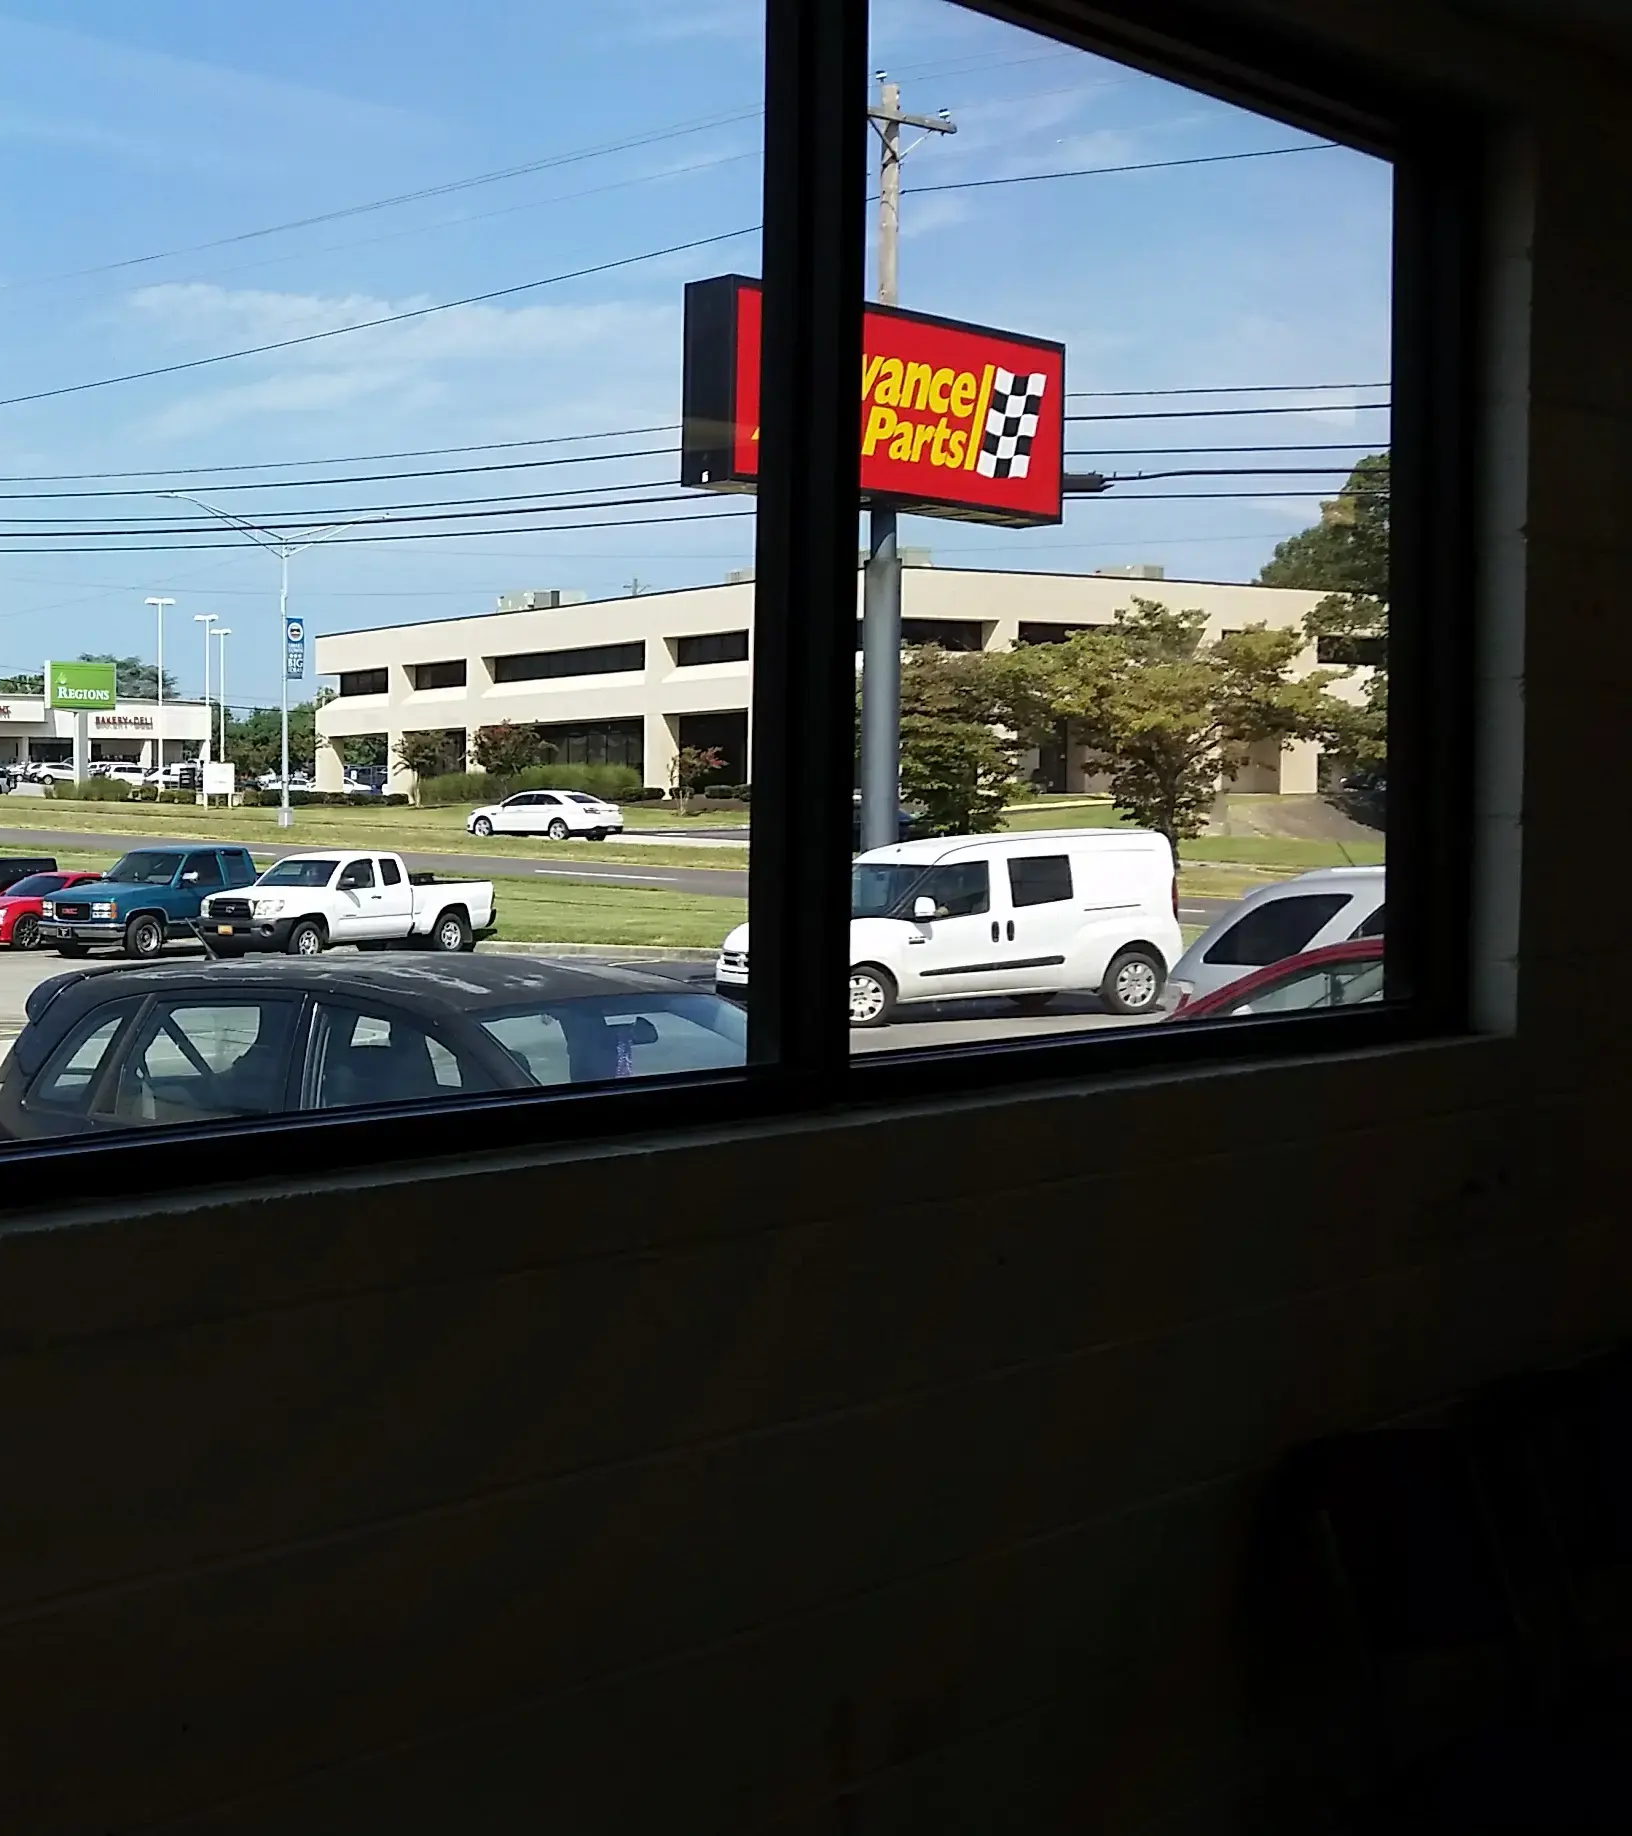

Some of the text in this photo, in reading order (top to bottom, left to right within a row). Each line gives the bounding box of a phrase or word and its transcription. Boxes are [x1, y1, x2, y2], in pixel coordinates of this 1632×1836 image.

[862, 354, 977, 418] vance
[861, 405, 968, 469] Parts
[288, 658, 304, 667] BIG
[57, 686, 110, 700] REGIONS
[95, 716, 128, 726] BAKERY
[133, 716, 153, 726] DELI
